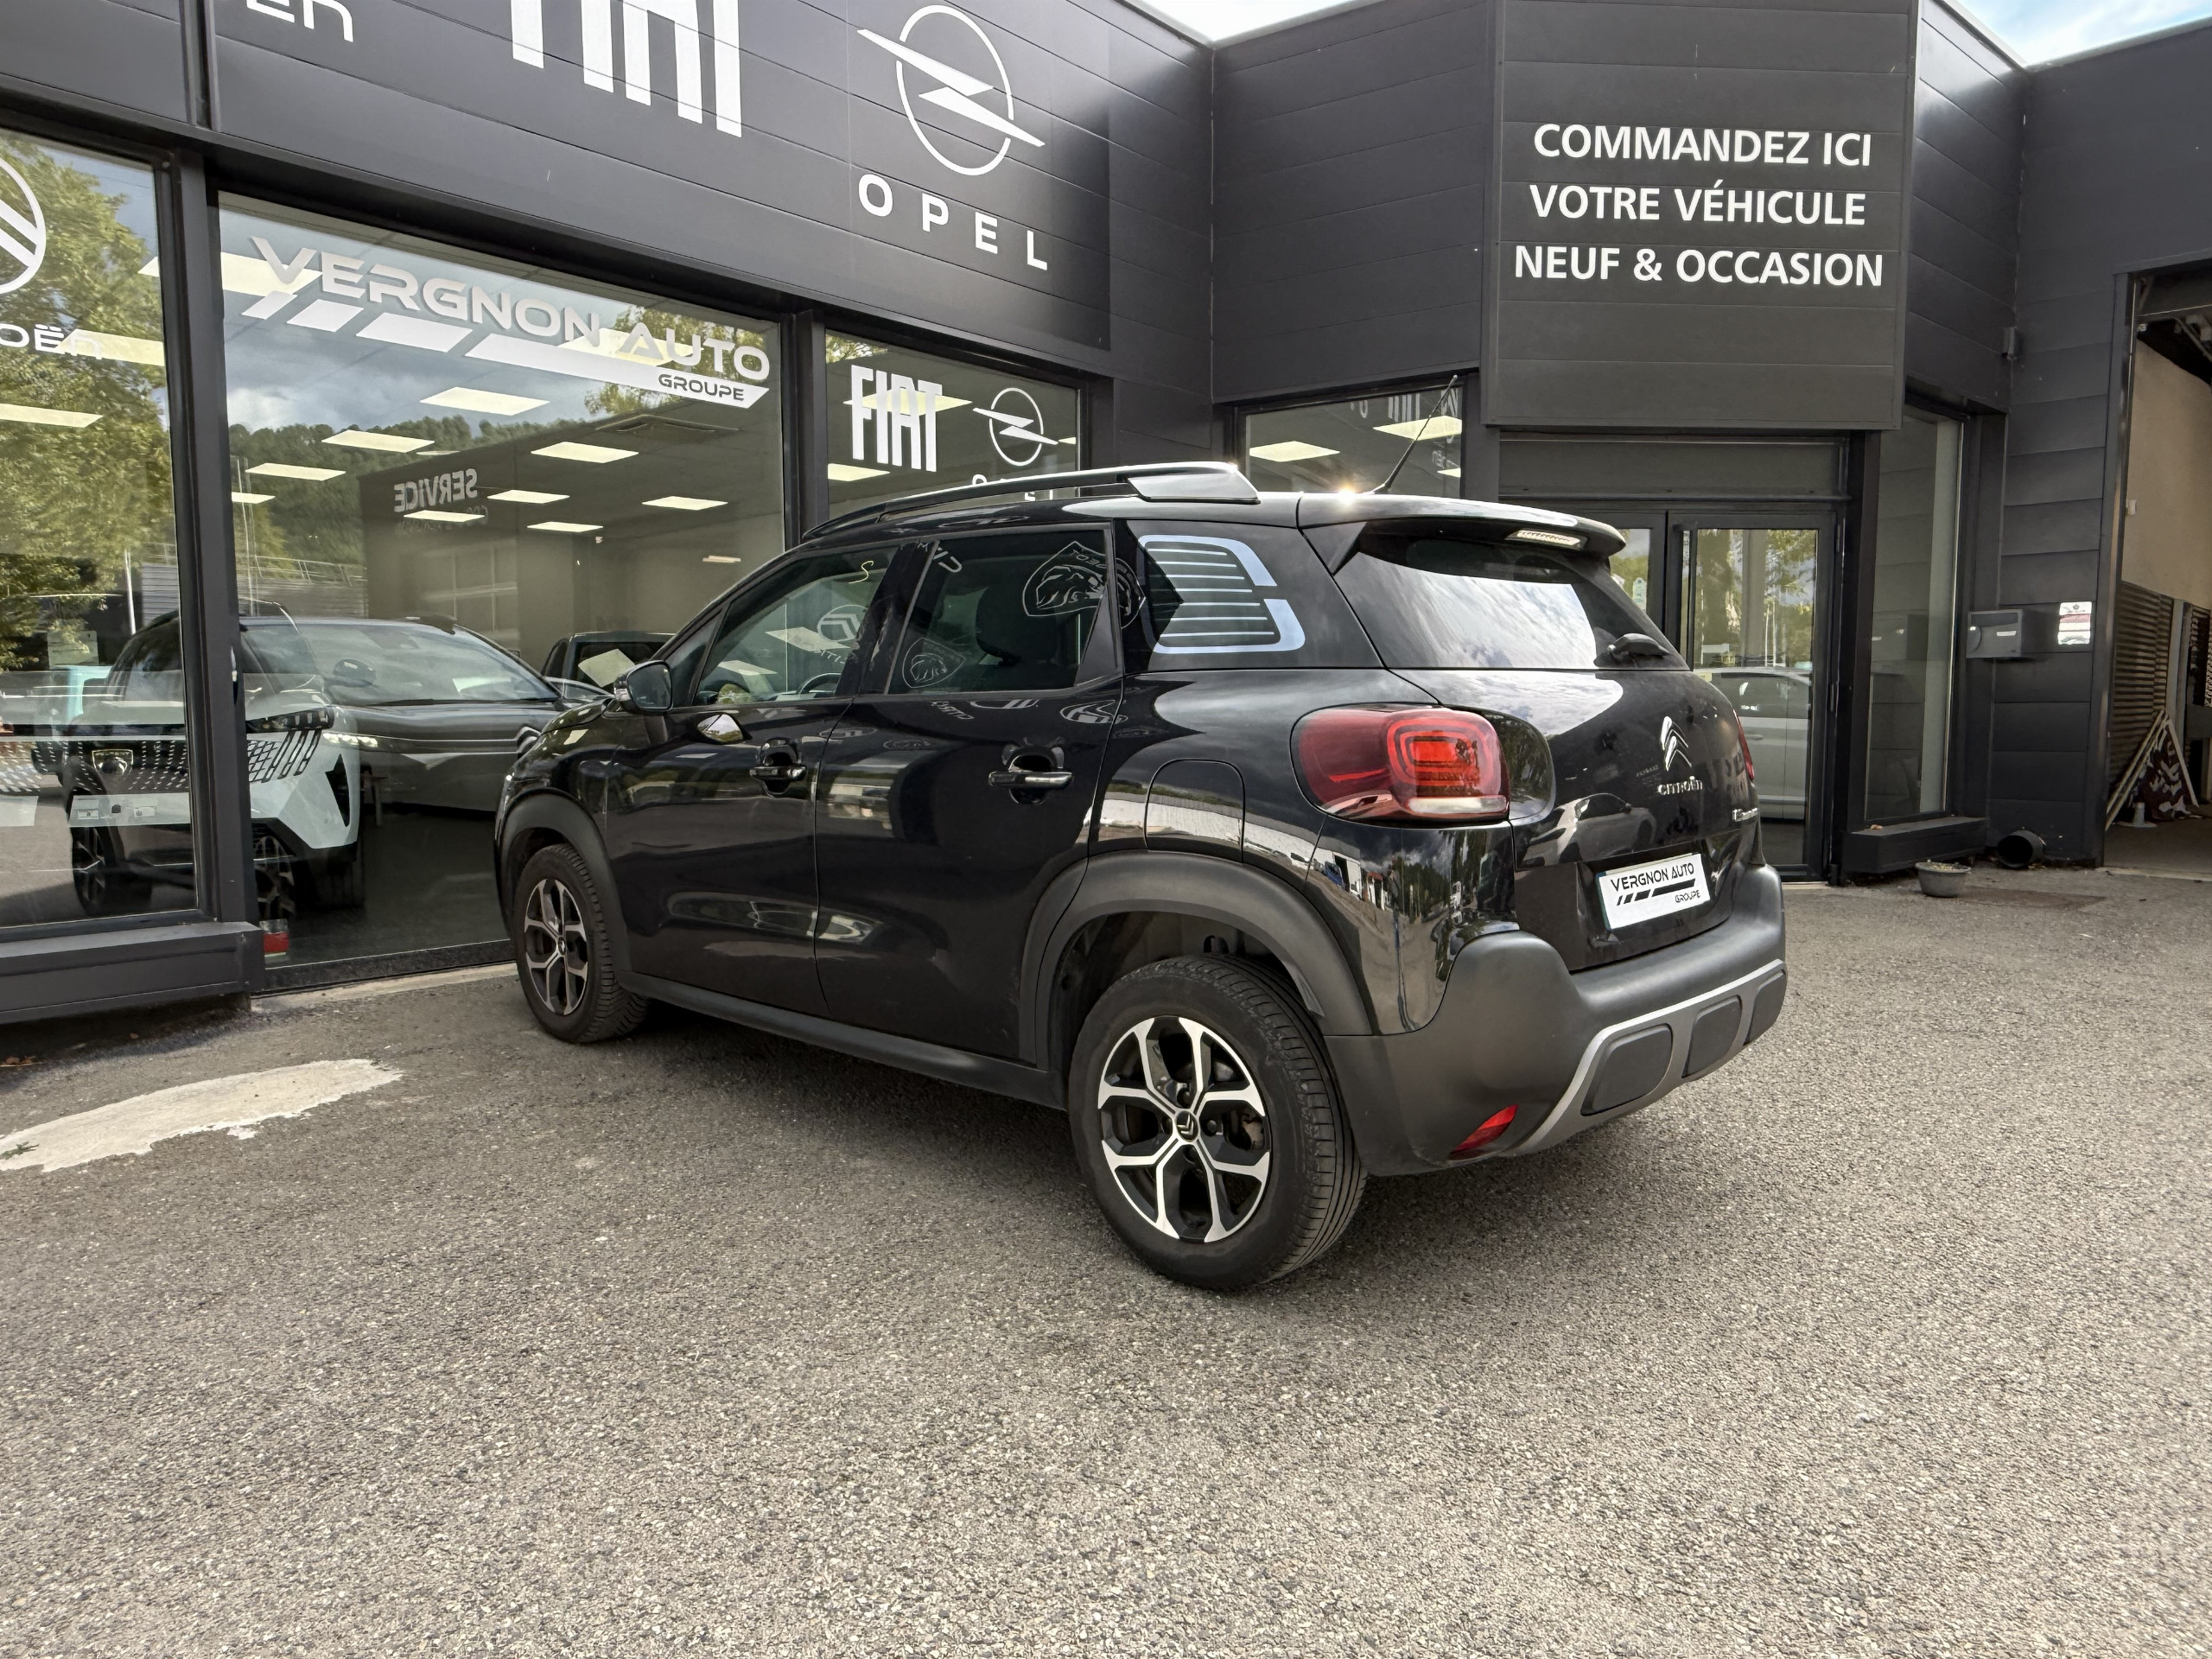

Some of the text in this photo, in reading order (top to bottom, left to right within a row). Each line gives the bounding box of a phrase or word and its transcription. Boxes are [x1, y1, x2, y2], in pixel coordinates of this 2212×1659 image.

[1535, 124, 1872, 167] COMMANDEZ ICI
[858, 175, 1047, 270] OPEL
[1529, 179, 1866, 226] VOTRE VÉHICULE
[1515, 245, 1883, 287] NEUF & OCCASION
[251, 236, 770, 380] VERGNON AUTO
[658, 373, 745, 401] GROUPE
[851, 365, 943, 472] FIAT
[1611, 862, 1694, 892] VERGNON AUTO
